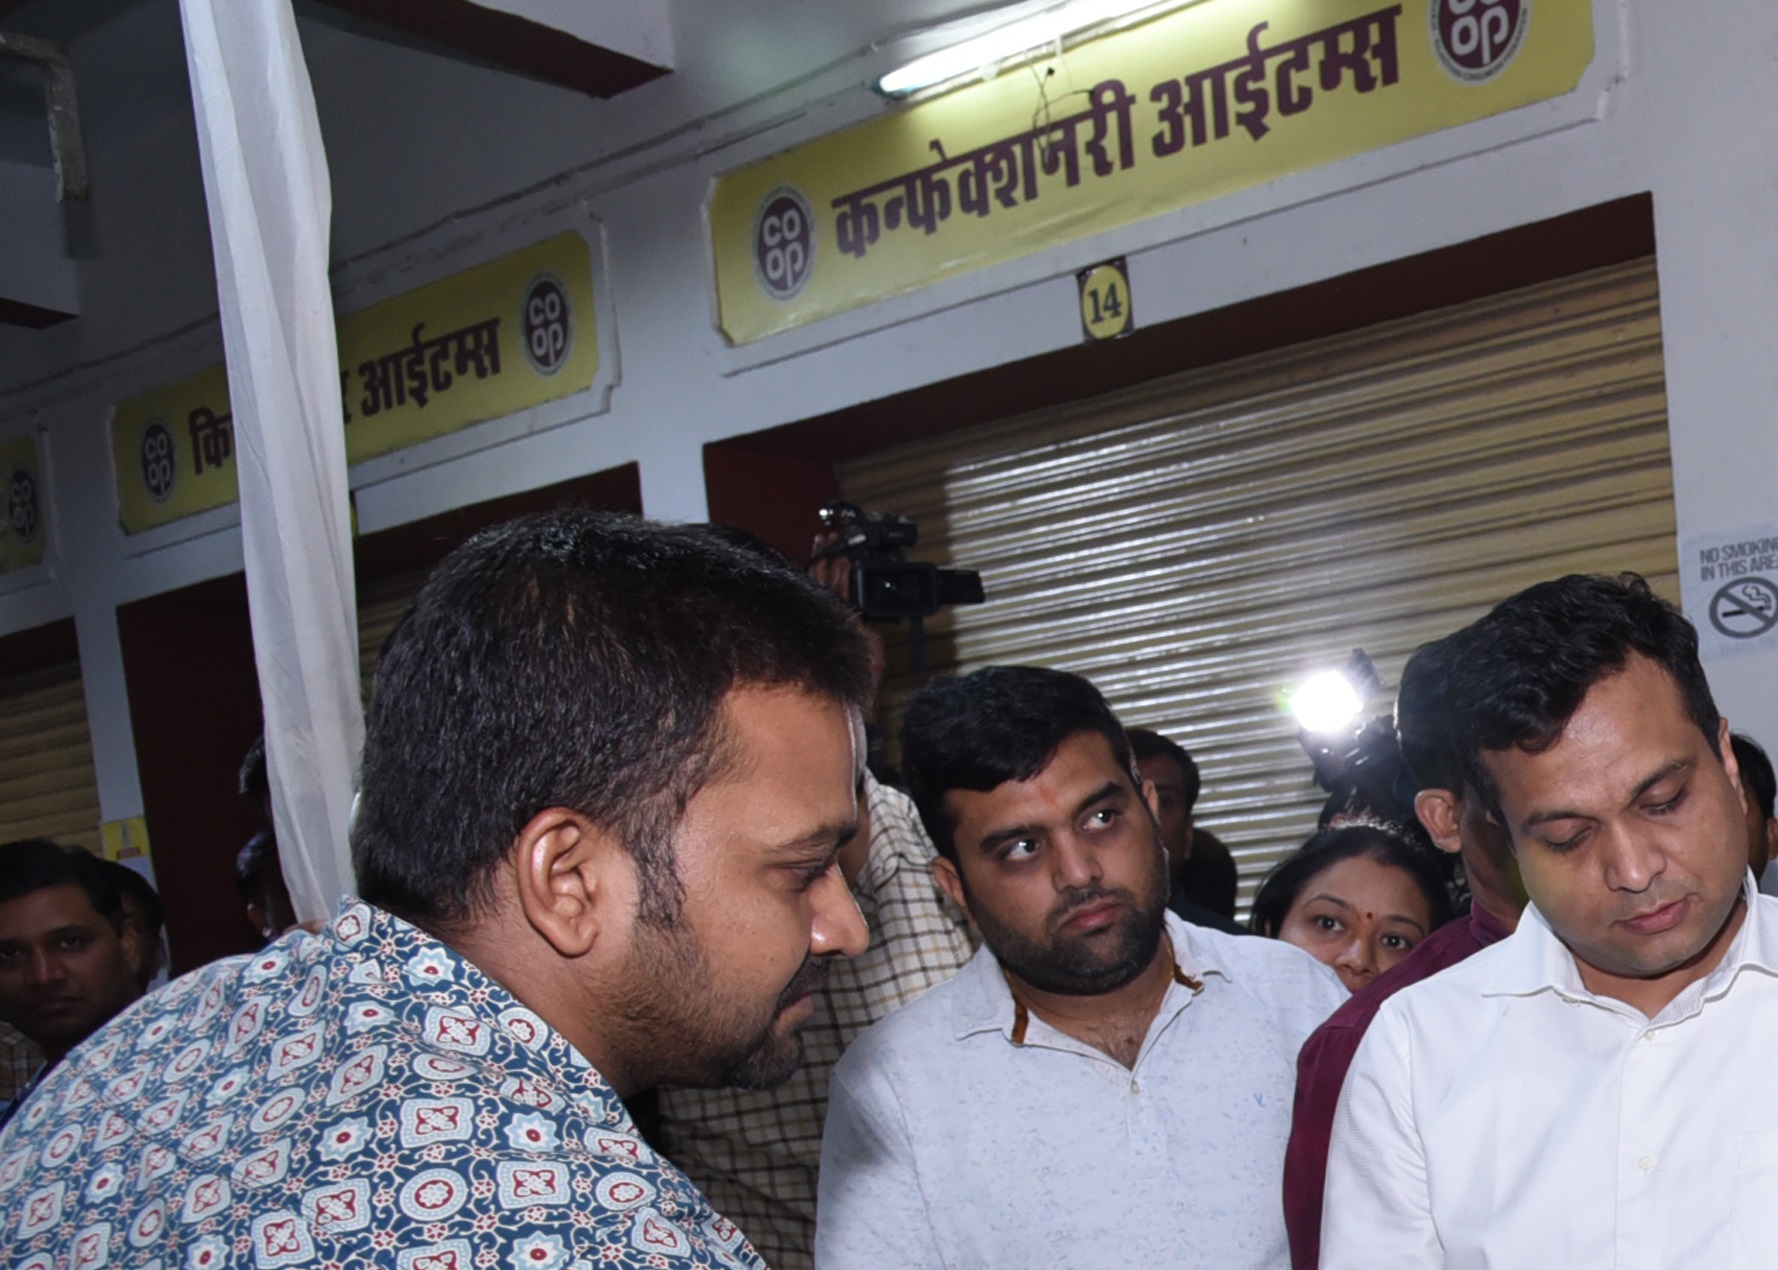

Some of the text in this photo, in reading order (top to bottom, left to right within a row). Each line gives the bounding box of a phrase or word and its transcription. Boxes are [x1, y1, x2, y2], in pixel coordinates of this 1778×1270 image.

[1150, 4, 1402, 157] आईटम्स
[1089, 283, 1121, 325] 14
[358, 317, 500, 417] आईटम्स
[1700, 546, 1719, 564] NO
[1701, 565, 1715, 581] IN
[1719, 559, 1747, 578] THIS
